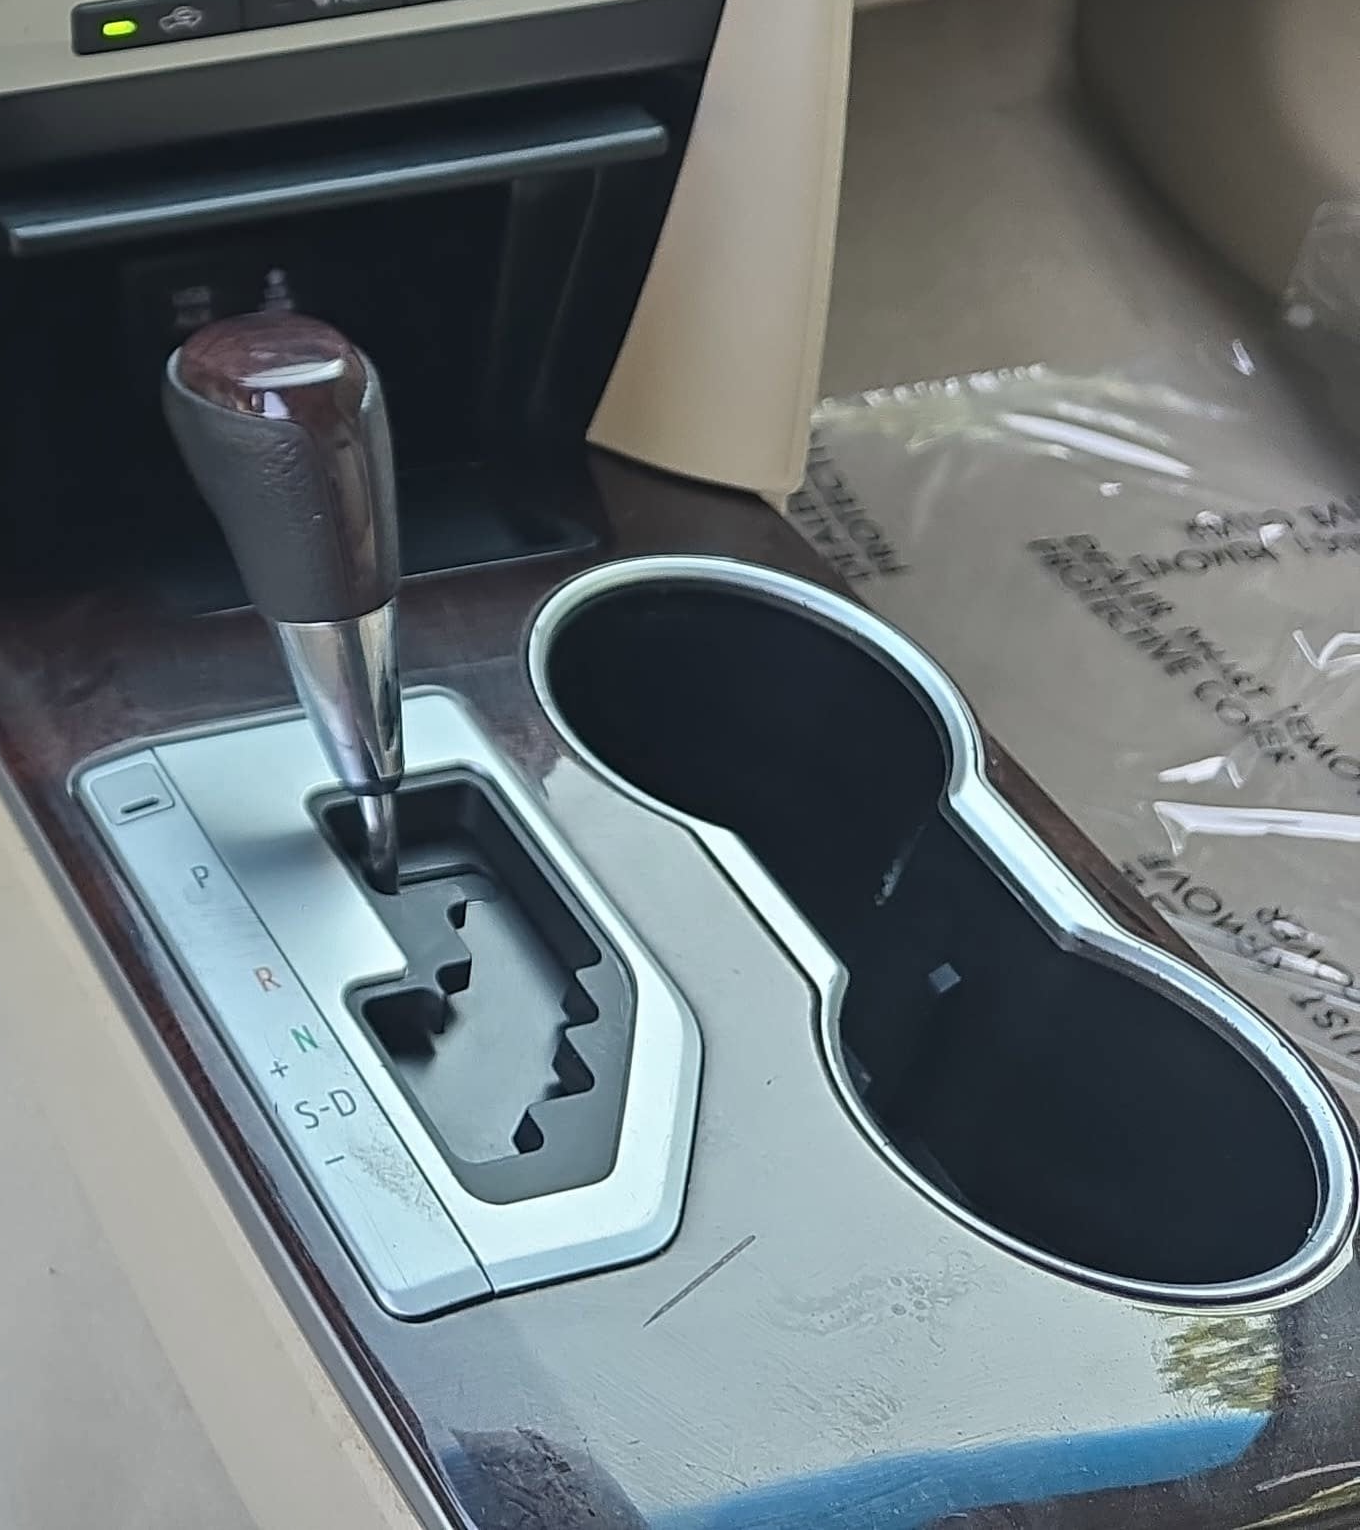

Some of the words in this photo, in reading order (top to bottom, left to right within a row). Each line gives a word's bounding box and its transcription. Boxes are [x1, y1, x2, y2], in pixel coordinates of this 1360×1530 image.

[190, 865, 210, 891] P
[254, 966, 282, 994] R
[291, 1025, 319, 1053] N
